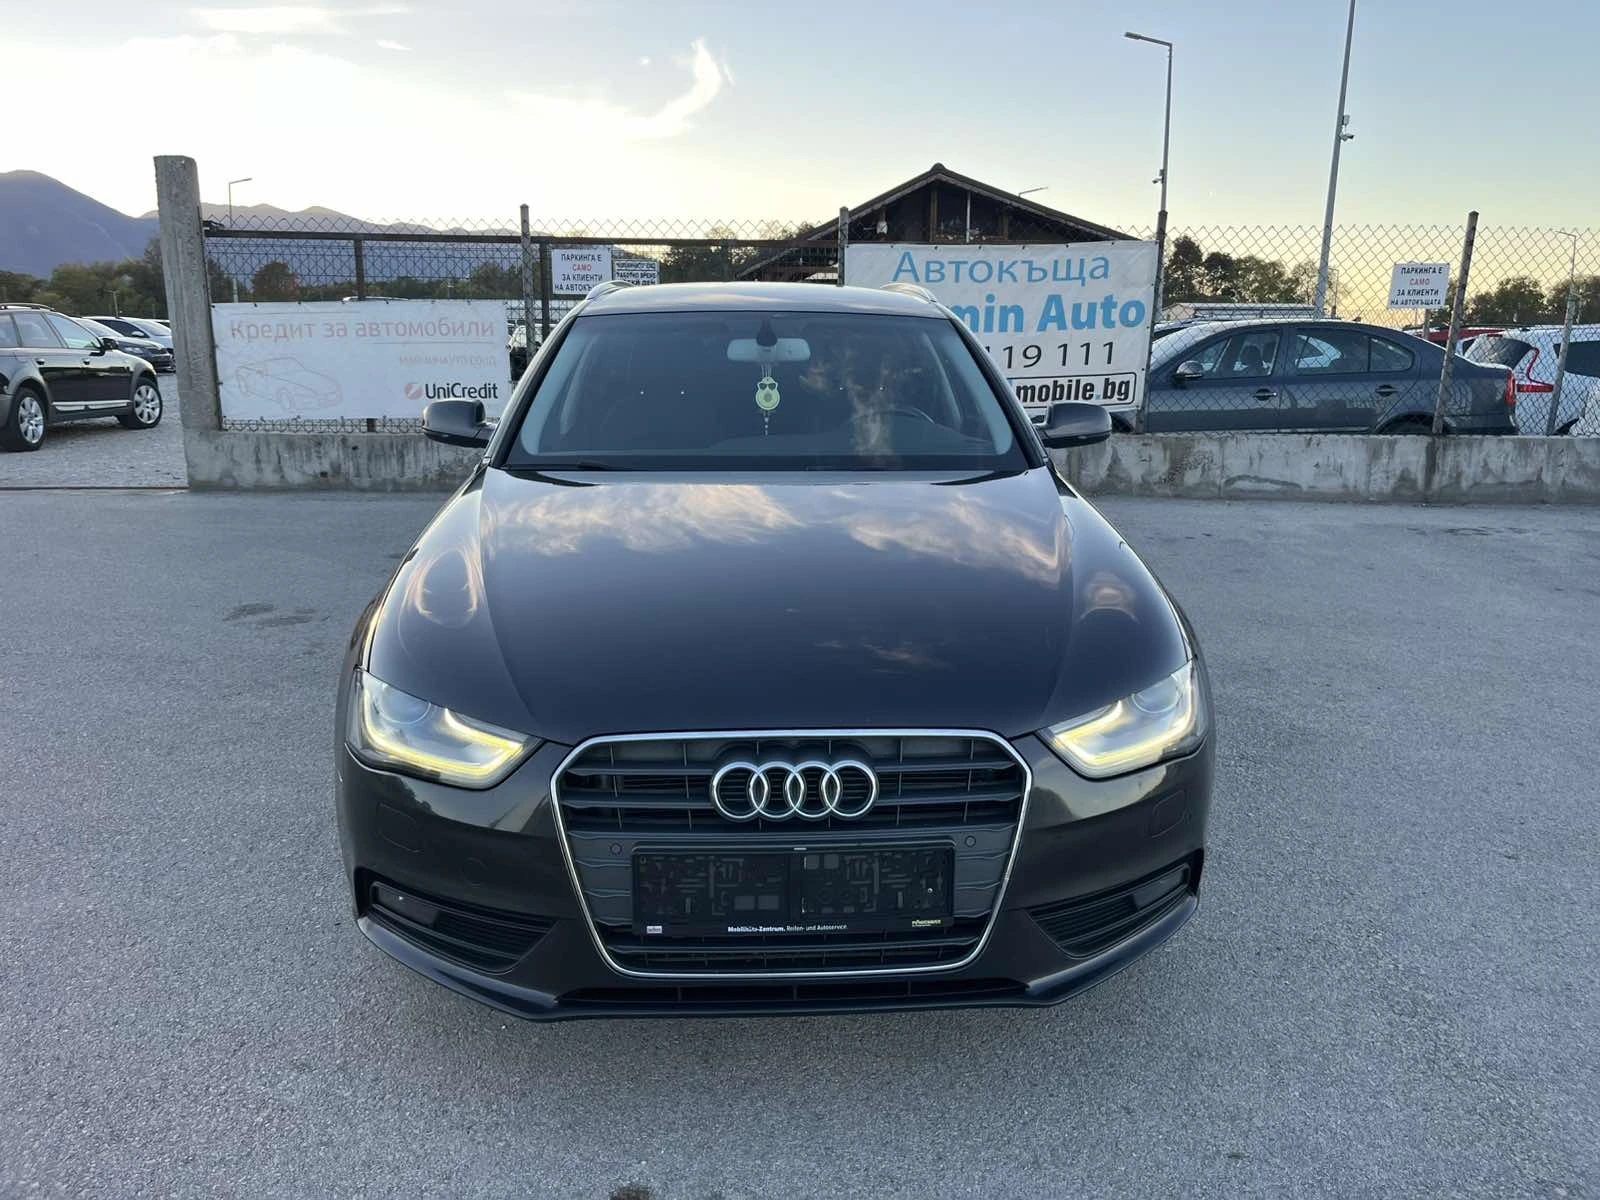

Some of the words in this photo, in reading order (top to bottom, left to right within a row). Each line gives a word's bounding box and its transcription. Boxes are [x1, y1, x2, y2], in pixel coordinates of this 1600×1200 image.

[561, 253, 595, 262] ПАРКИНГА
[572, 263, 592, 272] САМО
[891, 250, 1110, 287] Автокъща
[1401, 266, 1437, 274] ПАРКИНГА
[561, 273, 571, 281] ЗА
[572, 273, 603, 281] КЛИЕНТИ
[1409, 278, 1430, 286] САМО
[565, 283, 593, 291] АВТОКЪ
[1407, 288, 1439, 296] КЛИЕНТИ
[948, 293, 1024, 334] min
[1036, 293, 1146, 333] Auto
[231, 320, 315, 342] Кредит
[324, 321, 347, 337] за
[355, 316, 494, 338] автомобили
[984, 344, 1042, 369] 19
[1057, 341, 1114, 366] 111
[424, 381, 498, 399] UniCredit
